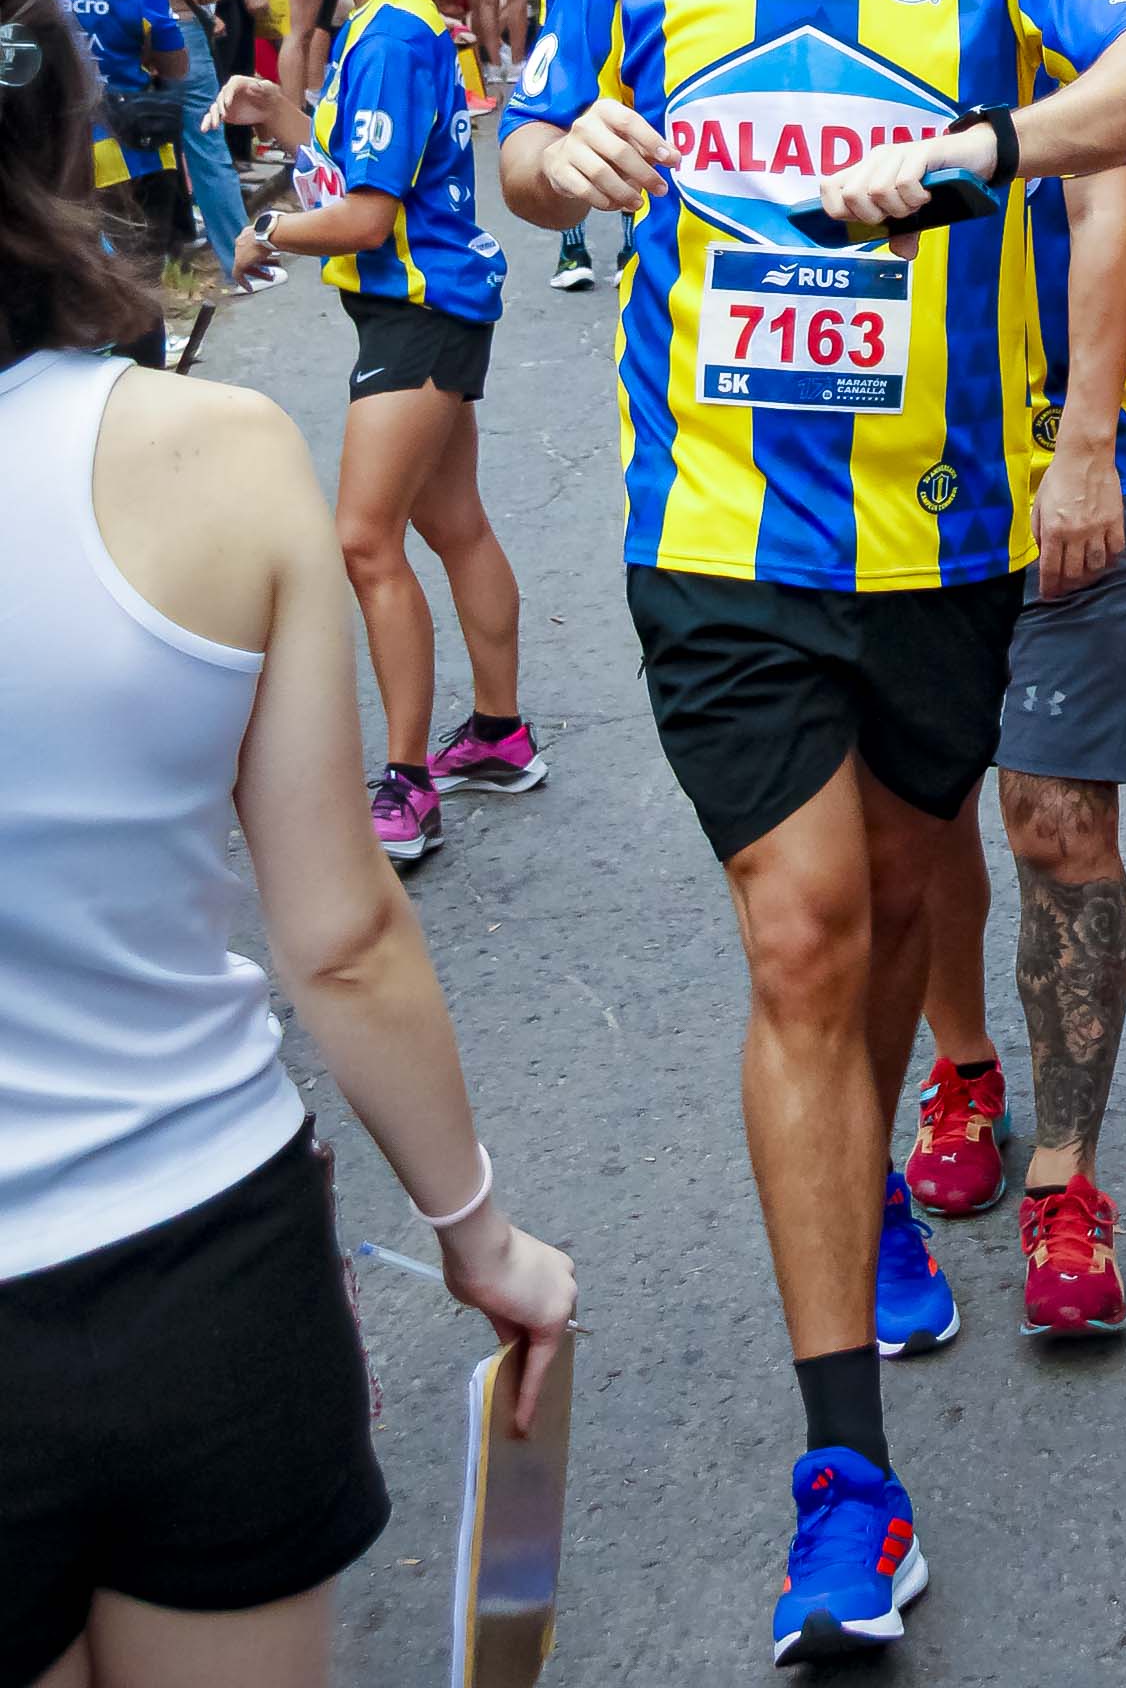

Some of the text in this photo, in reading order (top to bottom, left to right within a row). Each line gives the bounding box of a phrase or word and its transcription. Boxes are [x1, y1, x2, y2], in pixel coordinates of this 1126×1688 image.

[351, 109, 393, 152] 30
[671, 120, 951, 177] PALAD
[798, 267, 850, 289] RUS
[730, 304, 885, 368] 7163
[718, 372, 750, 394] 5K
[837, 378, 888, 387] MARATÓN
[837, 386, 886, 395] CANALLA
